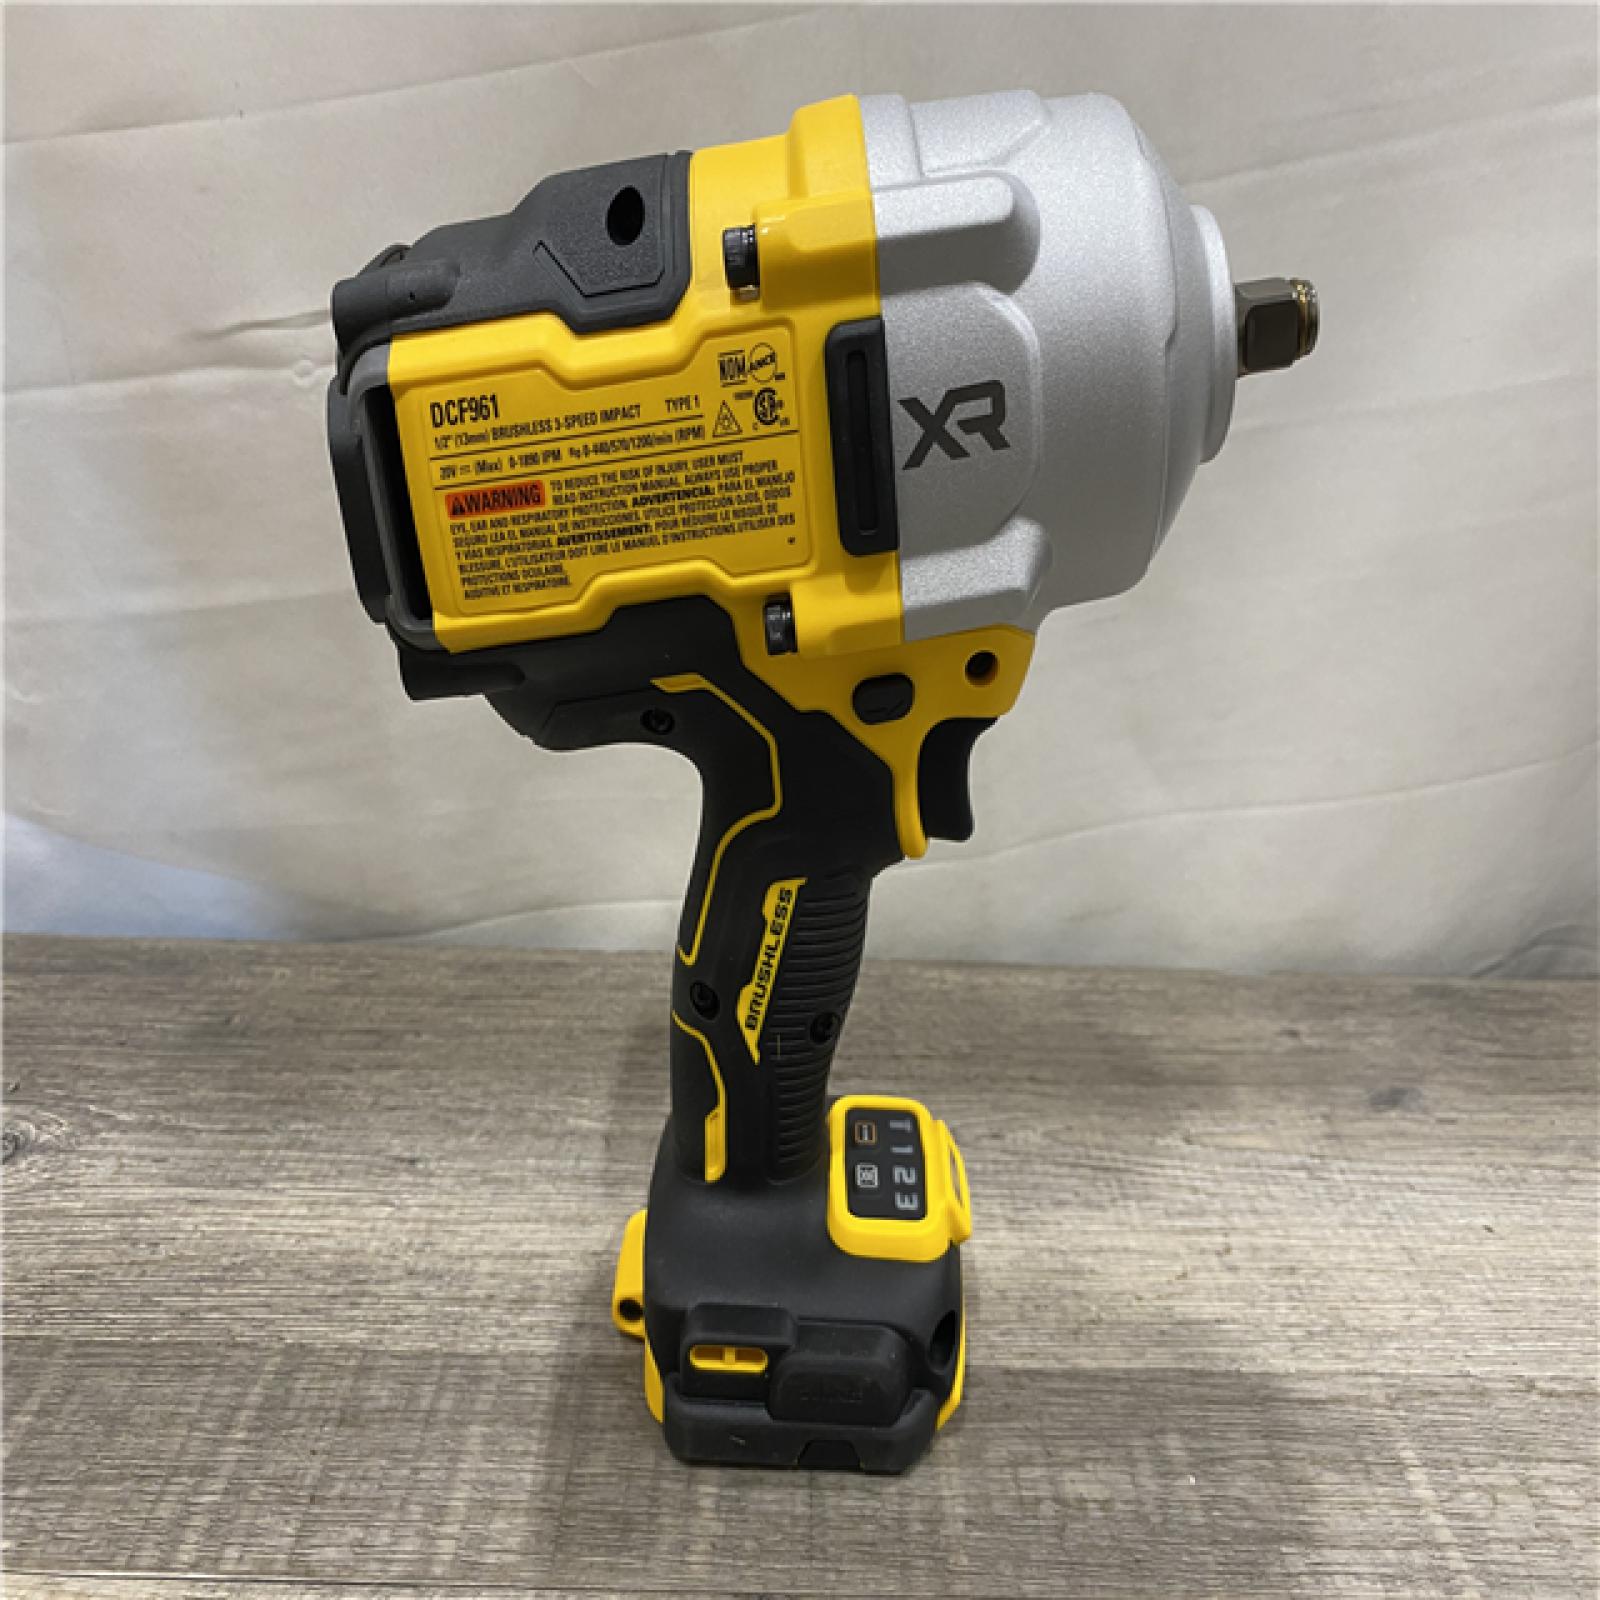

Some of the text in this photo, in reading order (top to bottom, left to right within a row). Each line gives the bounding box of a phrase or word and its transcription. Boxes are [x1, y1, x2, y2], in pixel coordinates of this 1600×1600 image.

[430, 393, 499, 428] DCF961
[665, 395, 691, 413] TYPE
[492, 417, 552, 441] BRUSHLESS
[600, 403, 640, 423] IMPACT
[897, 379, 1011, 470] XR
[564, 475, 599, 491] REDUCE
[601, 472, 617, 484] THE
[619, 468, 640, 482] RISK
[642, 465, 653, 478] OF
[717, 450, 743, 466] MUST
[579, 483, 639, 502] INSTRUCTION
[684, 470, 720, 485] ALWAYS
[723, 465, 740, 479] USE
[742, 460, 778, 476] PROPER
[464, 482, 541, 514] WARNING
[490, 517, 508, 529] AND
[745, 887, 792, 1031] BRUSHLESS
[893, 1165, 916, 1185] 2
[895, 1191, 919, 1211] 3
